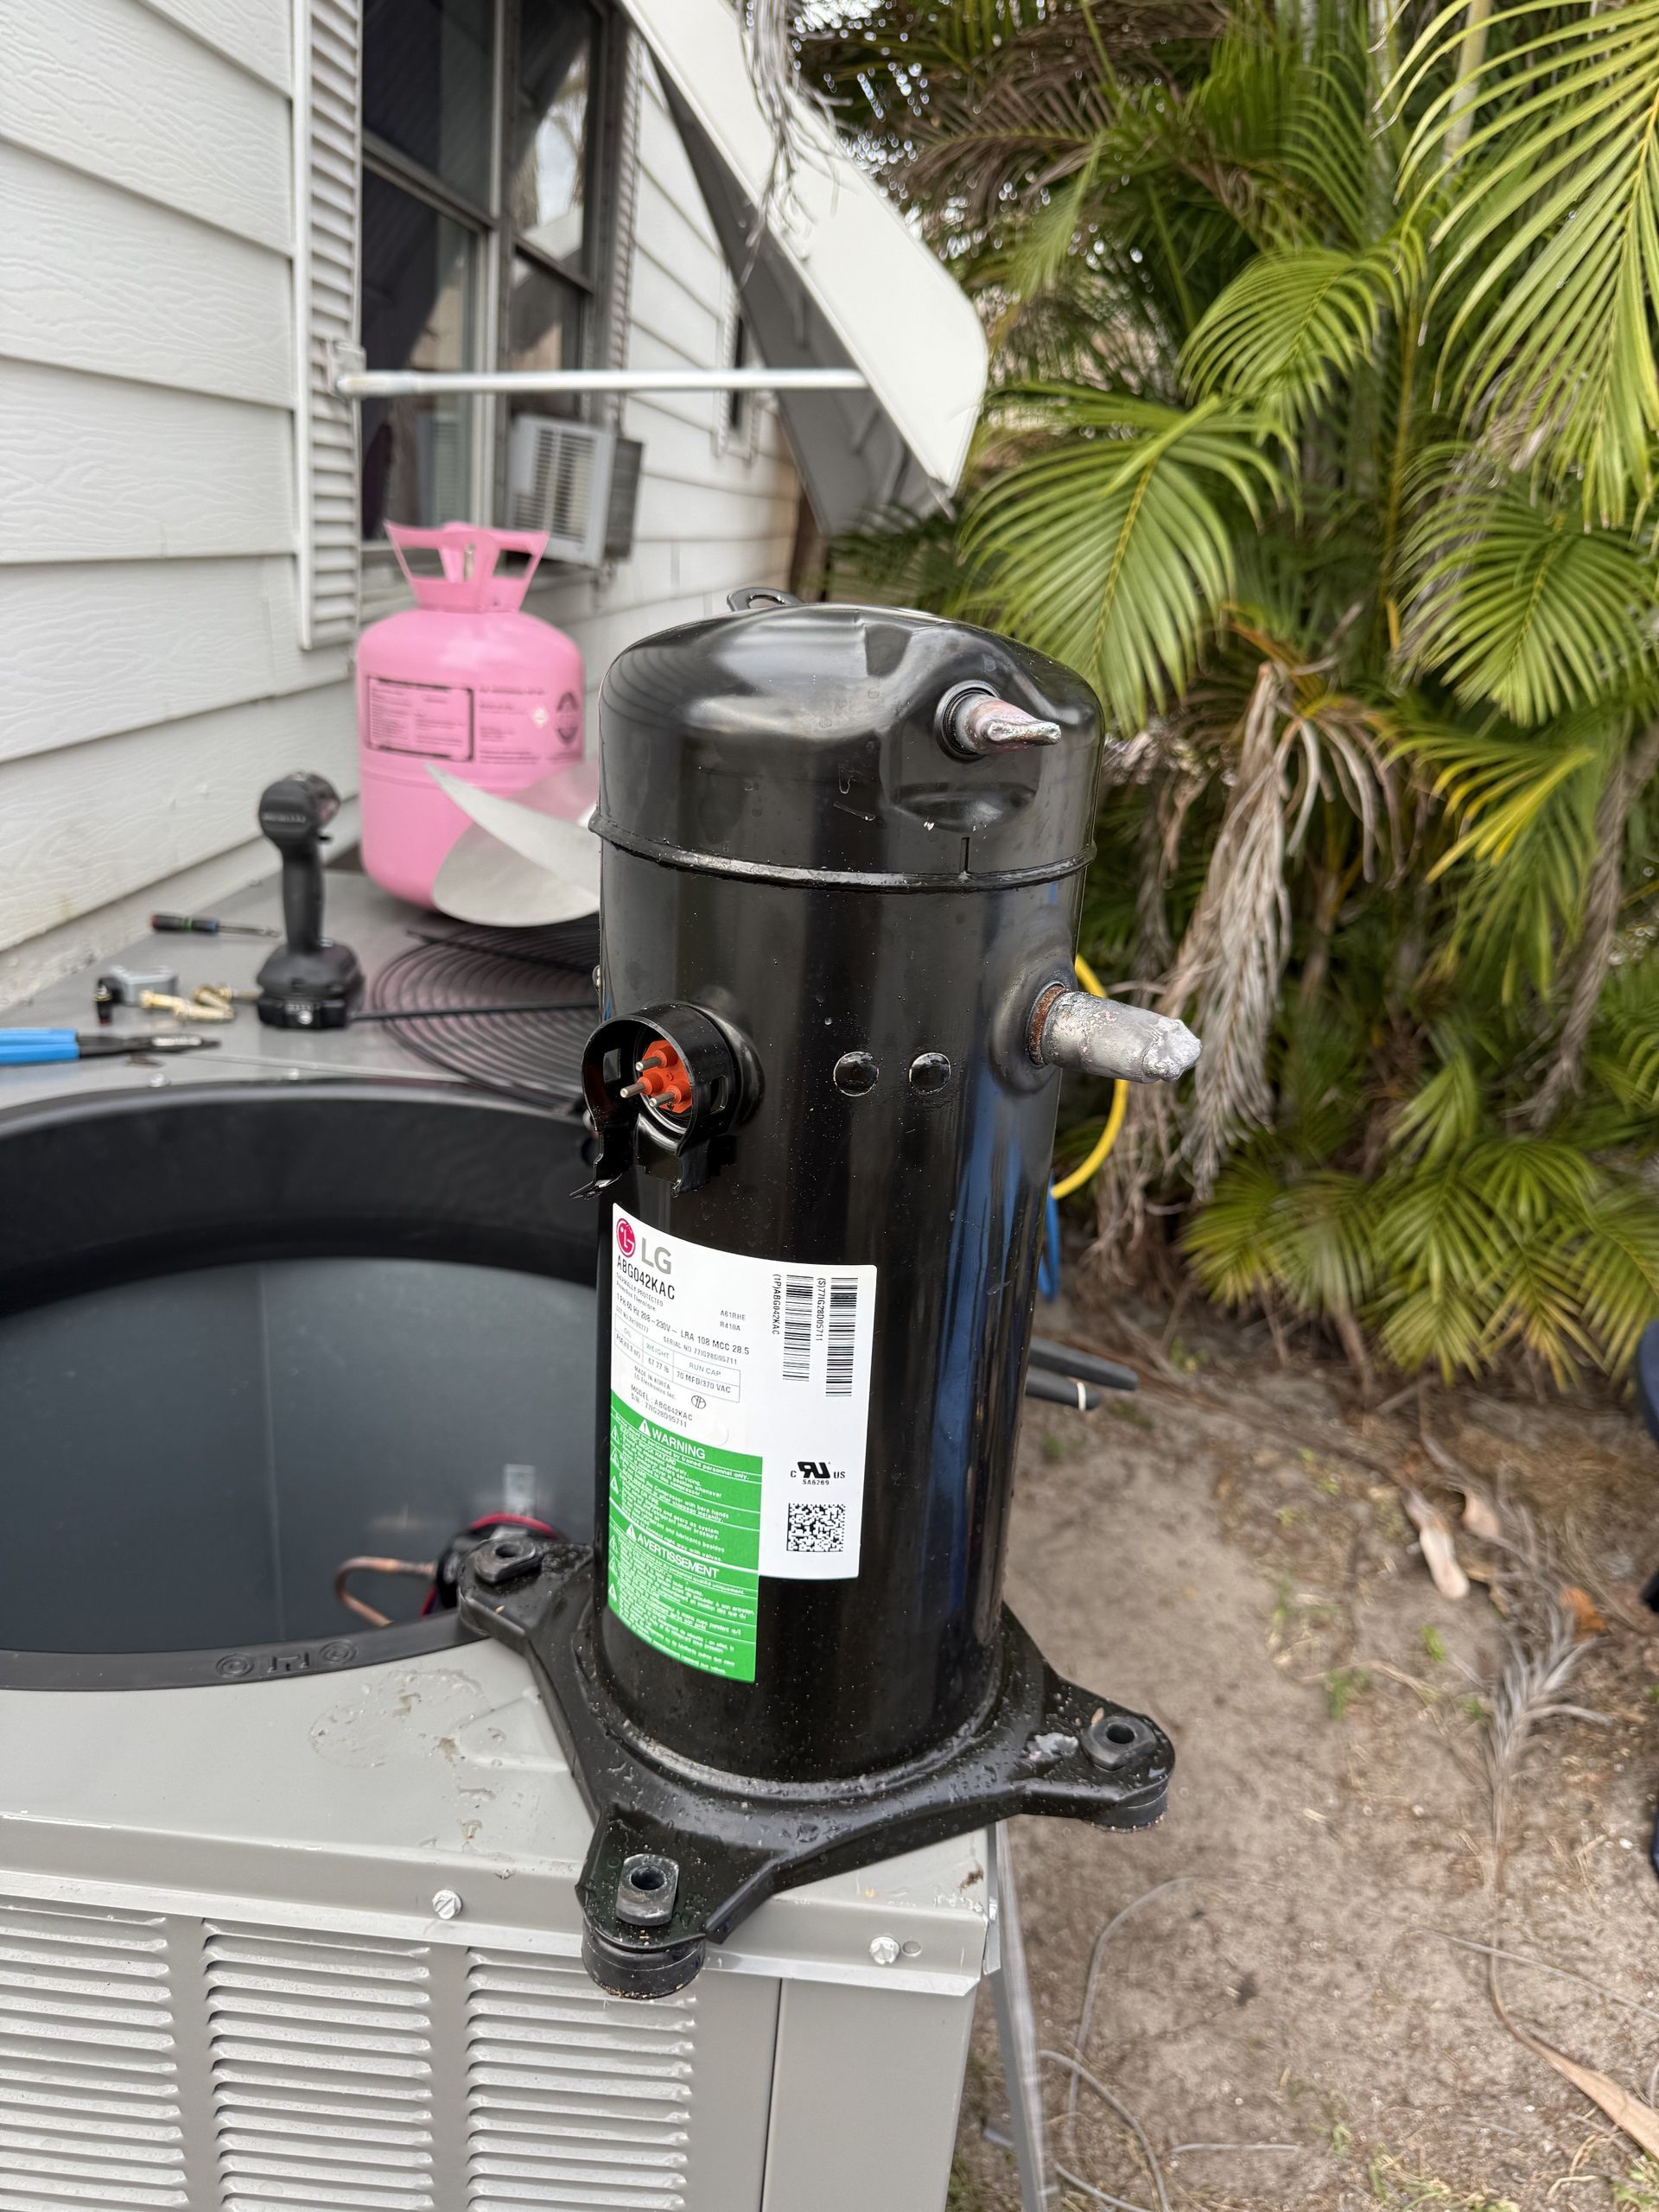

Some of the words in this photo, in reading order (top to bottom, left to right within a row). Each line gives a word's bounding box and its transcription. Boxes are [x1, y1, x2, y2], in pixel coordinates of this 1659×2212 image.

[641, 1237, 671, 1274] LG
[617, 1255, 675, 1300] ABG042KAC
[637, 1288, 664, 1307] PROTECTED
[772, 1274, 782, 1335] (1P)ABG042KAC
[720, 1321, 741, 1332] R410A
[680, 1330, 695, 1342] LRA
[697, 1335, 710, 1346] 108
[712, 1339, 730, 1351] MCC
[732, 1344, 750, 1356] 28.5
[689, 1362, 704, 1372] RUN
[705, 1368, 721, 1376] CAP
[716, 1383, 731, 1394] VAC
[652, 1427, 706, 1460] WARNING
[833, 1471, 846, 1479] US
[637, 1533, 720, 1580] AVERTISSEMENT
